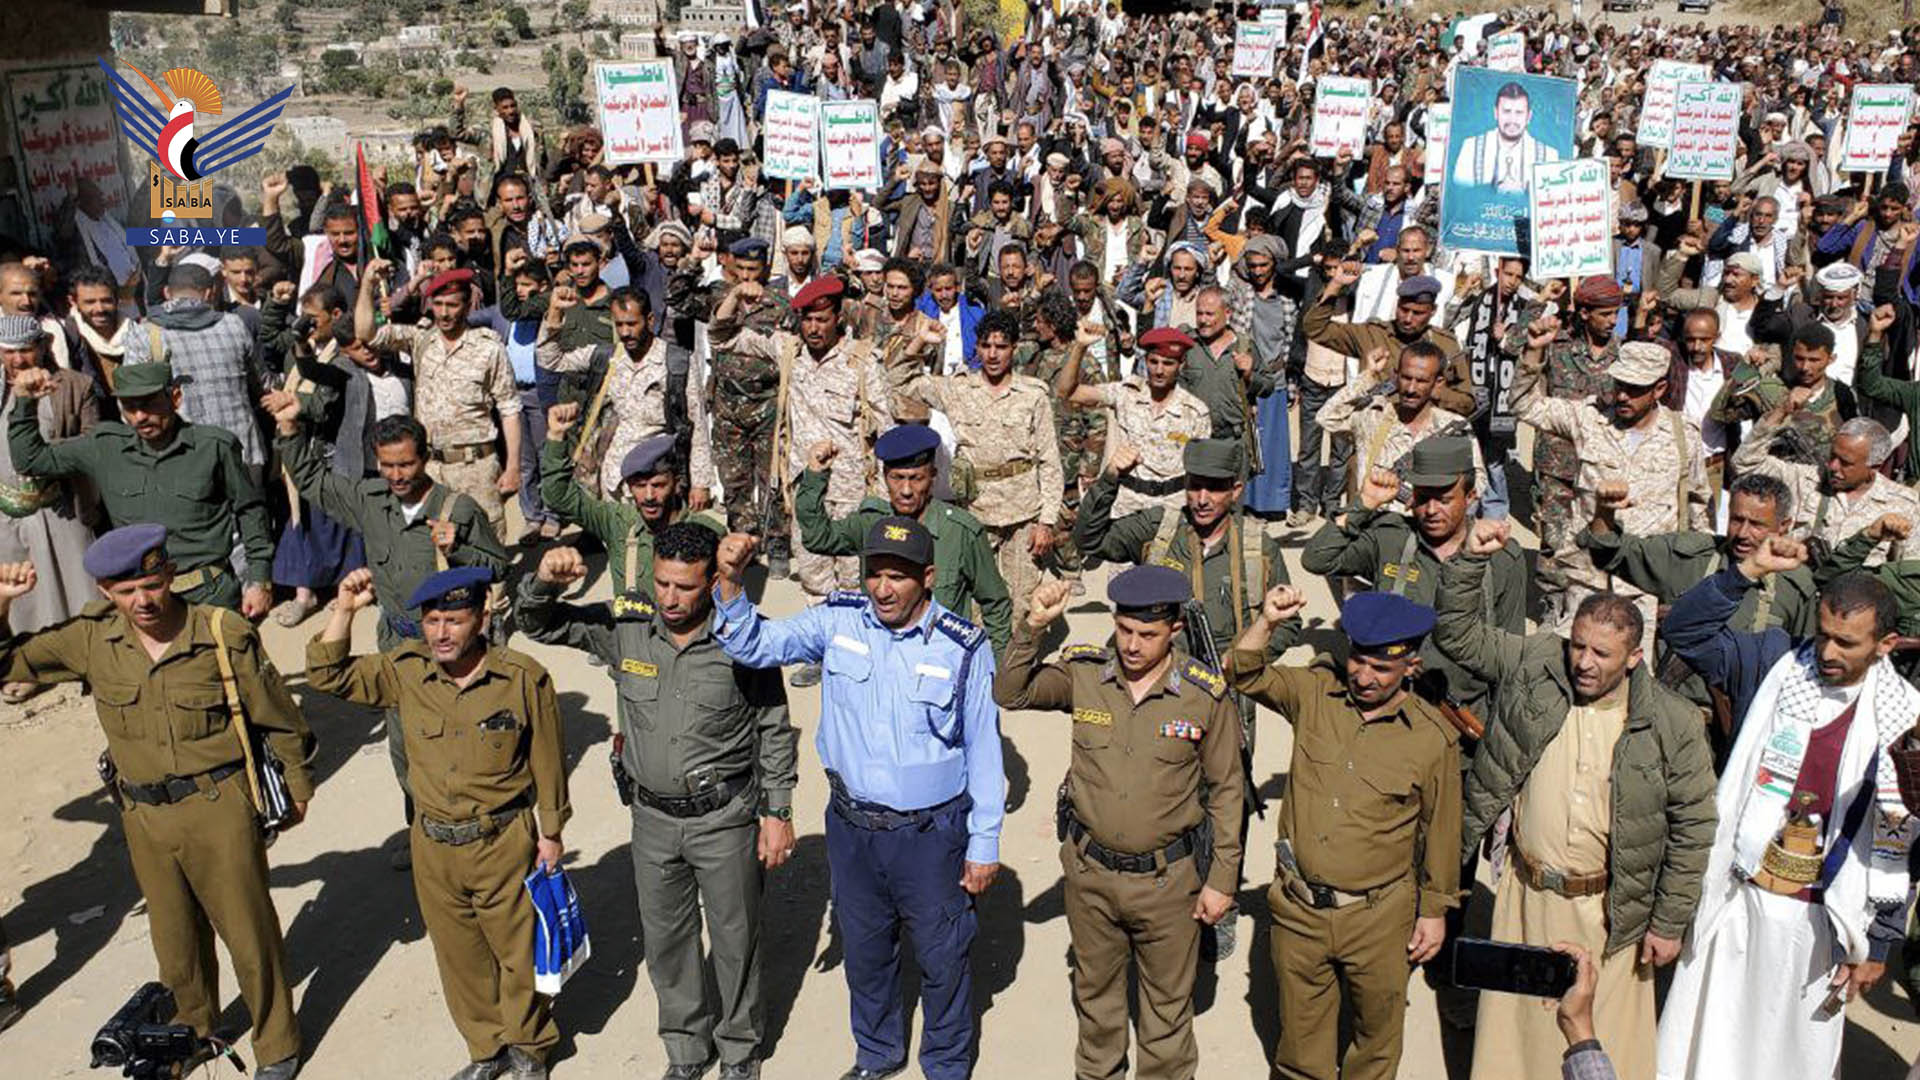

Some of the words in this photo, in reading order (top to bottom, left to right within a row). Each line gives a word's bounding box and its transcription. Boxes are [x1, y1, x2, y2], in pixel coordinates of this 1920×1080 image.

[602, 65, 665, 90] قاطعوا
[1715, 87, 1738, 102] الله
[1538, 165, 1575, 193] أكبر
[1579, 163, 1605, 182] الله
